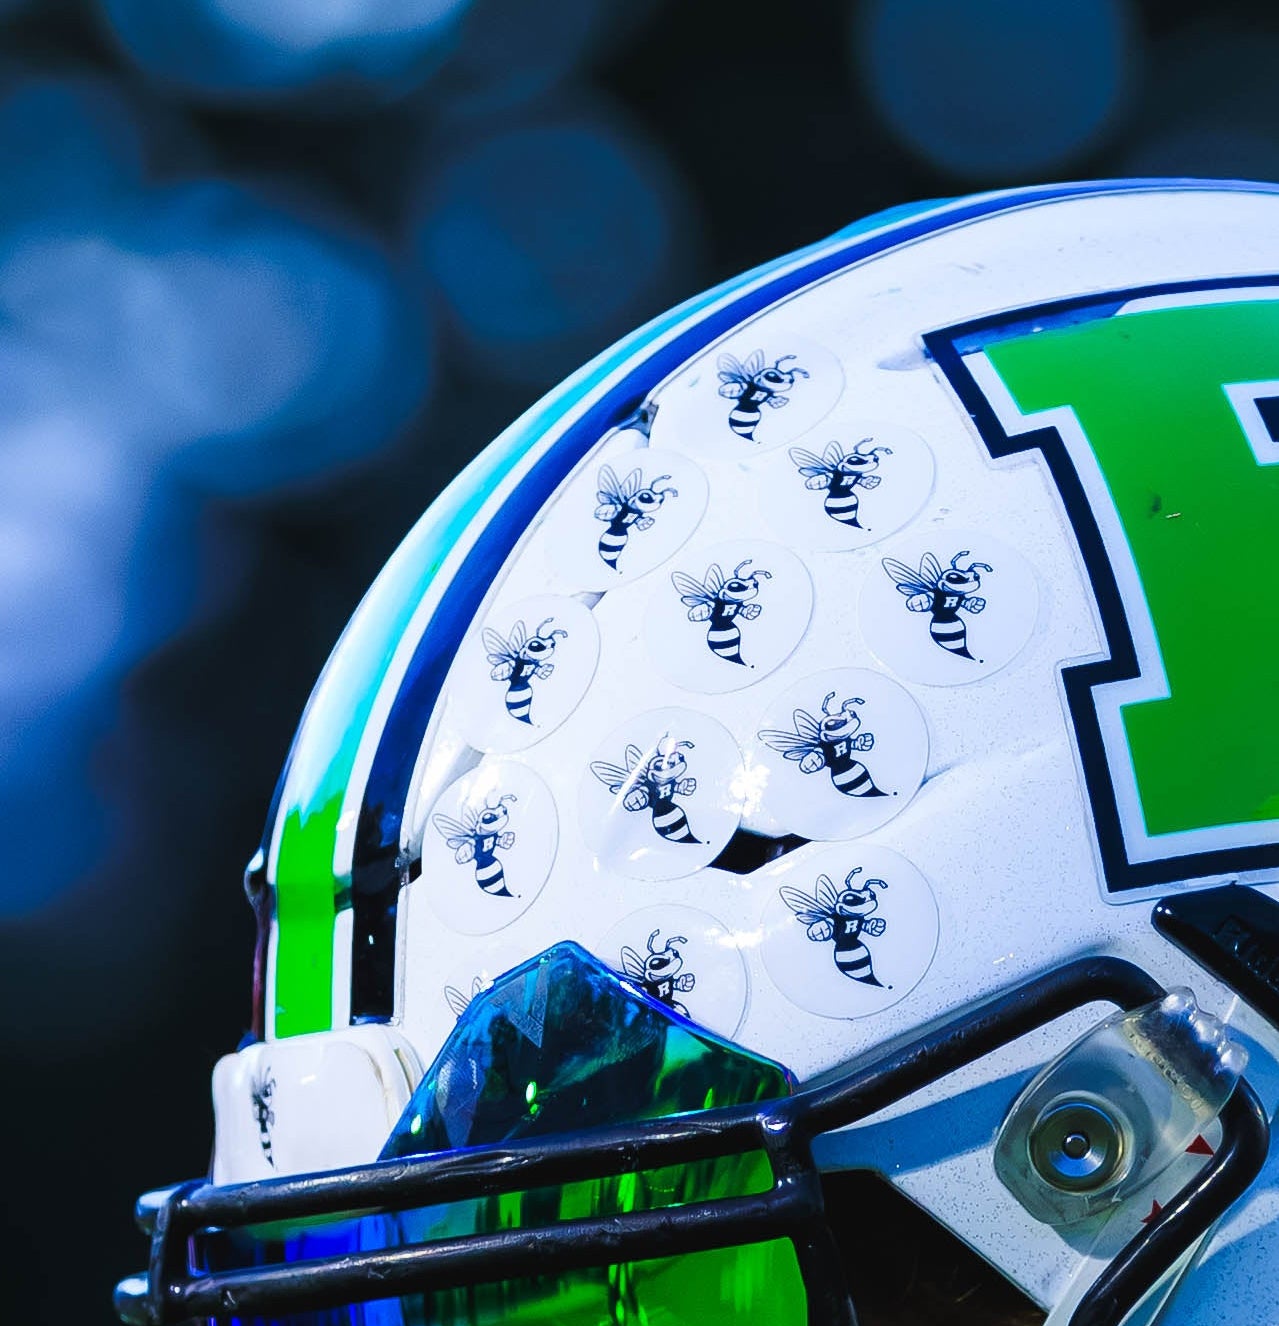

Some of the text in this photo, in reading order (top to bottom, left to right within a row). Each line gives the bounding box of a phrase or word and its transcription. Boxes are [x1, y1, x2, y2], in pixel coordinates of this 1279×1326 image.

[834, 741, 848, 758] R
[845, 921, 859, 934] R
[657, 982, 670, 998] R
